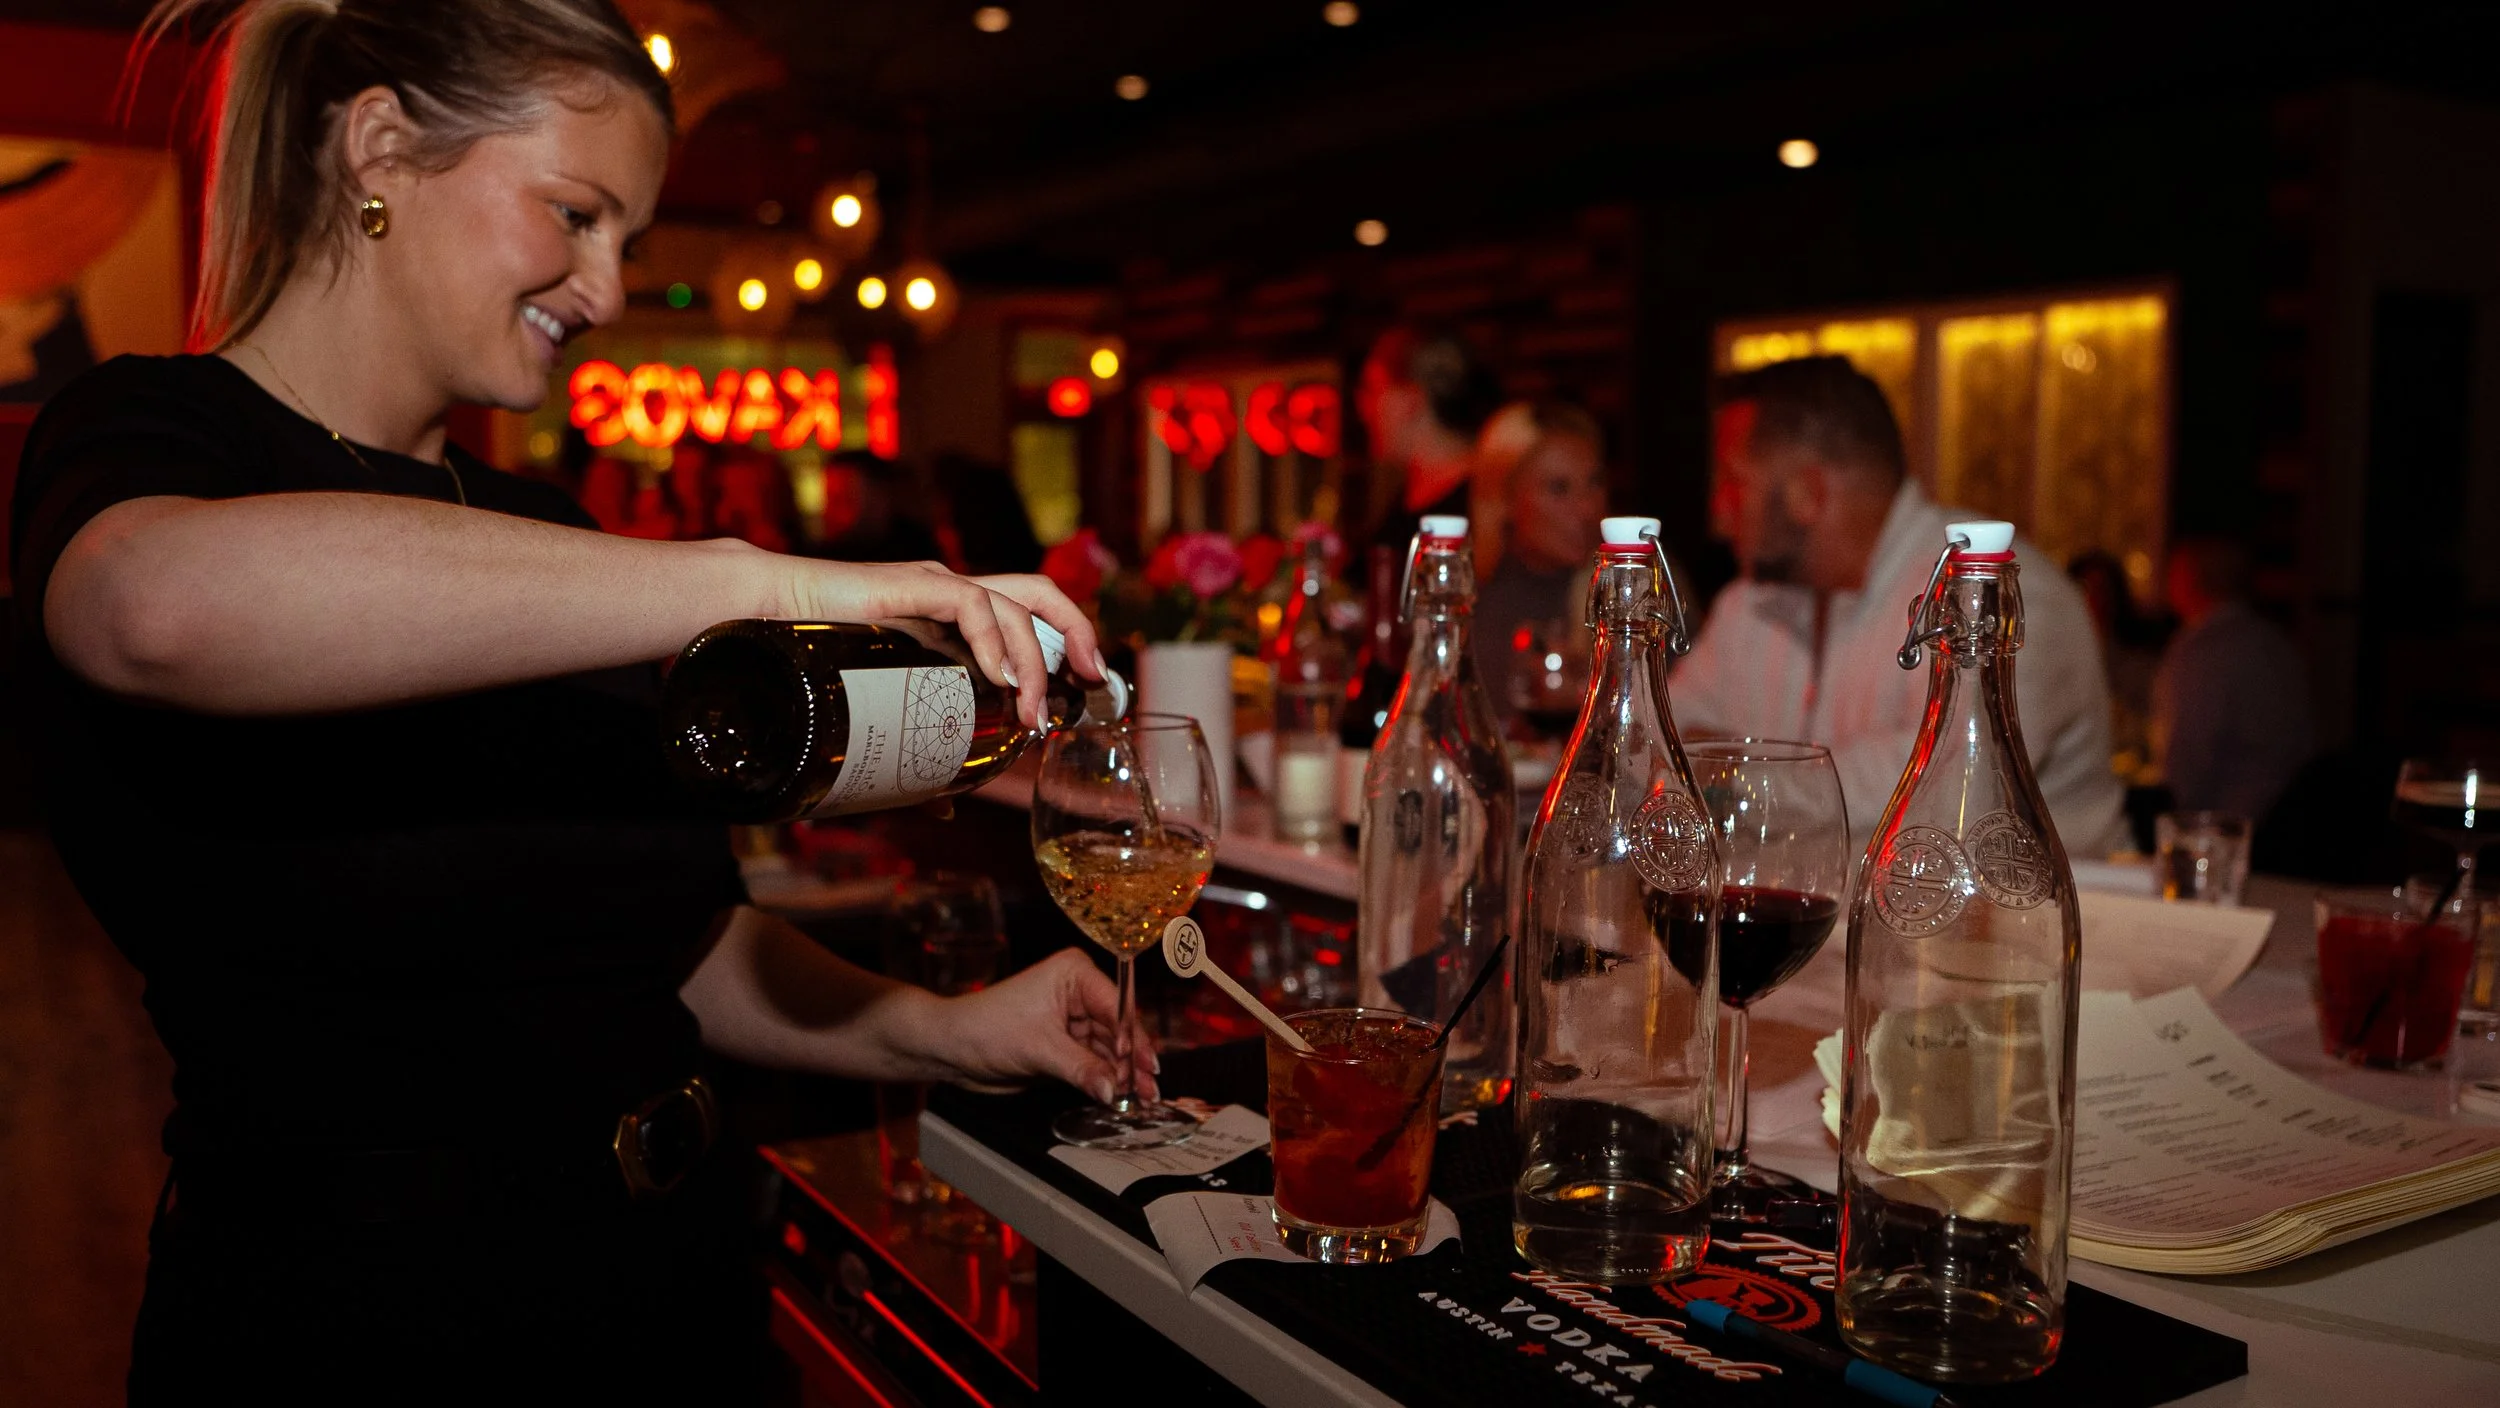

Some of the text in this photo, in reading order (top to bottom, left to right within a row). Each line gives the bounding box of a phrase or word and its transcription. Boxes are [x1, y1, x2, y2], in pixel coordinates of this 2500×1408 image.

[872, 730, 887, 765] THE
[1418, 1291, 1657, 1408] AUSTIN TEXA
[1500, 1296, 1654, 1383] VODKA
[1510, 1270, 1783, 1382] Handmade
